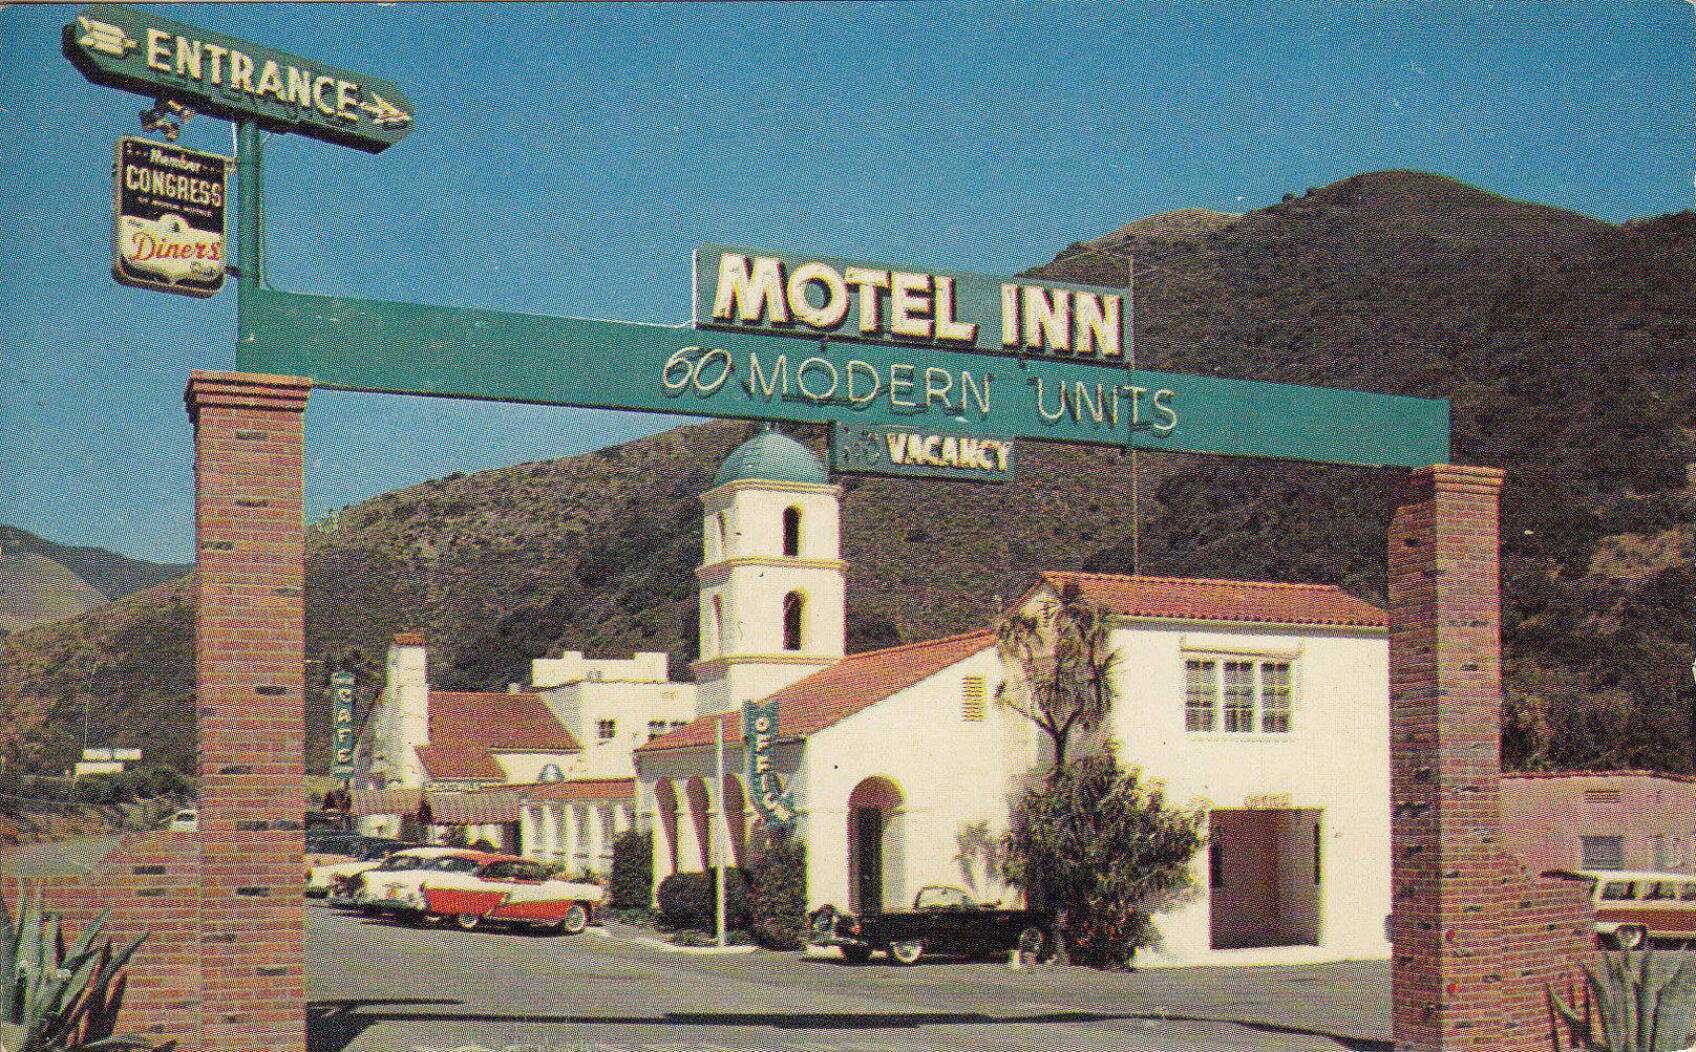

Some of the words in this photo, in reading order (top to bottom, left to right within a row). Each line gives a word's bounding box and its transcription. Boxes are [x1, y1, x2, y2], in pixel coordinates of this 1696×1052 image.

[147, 27, 360, 122] ENTRANCE
[126, 164, 222, 208] CONGRESS
[129, 230, 222, 263] Diners
[712, 251, 978, 343] MOTEL
[1001, 281, 1122, 357] INN
[662, 345, 733, 392] 60
[746, 352, 992, 414] MODERN
[1037, 377, 1178, 431] UNITS
[886, 431, 1014, 472] VACANCY
[337, 687, 352, 764] CAFE
[755, 717, 792, 822] OFFICE
